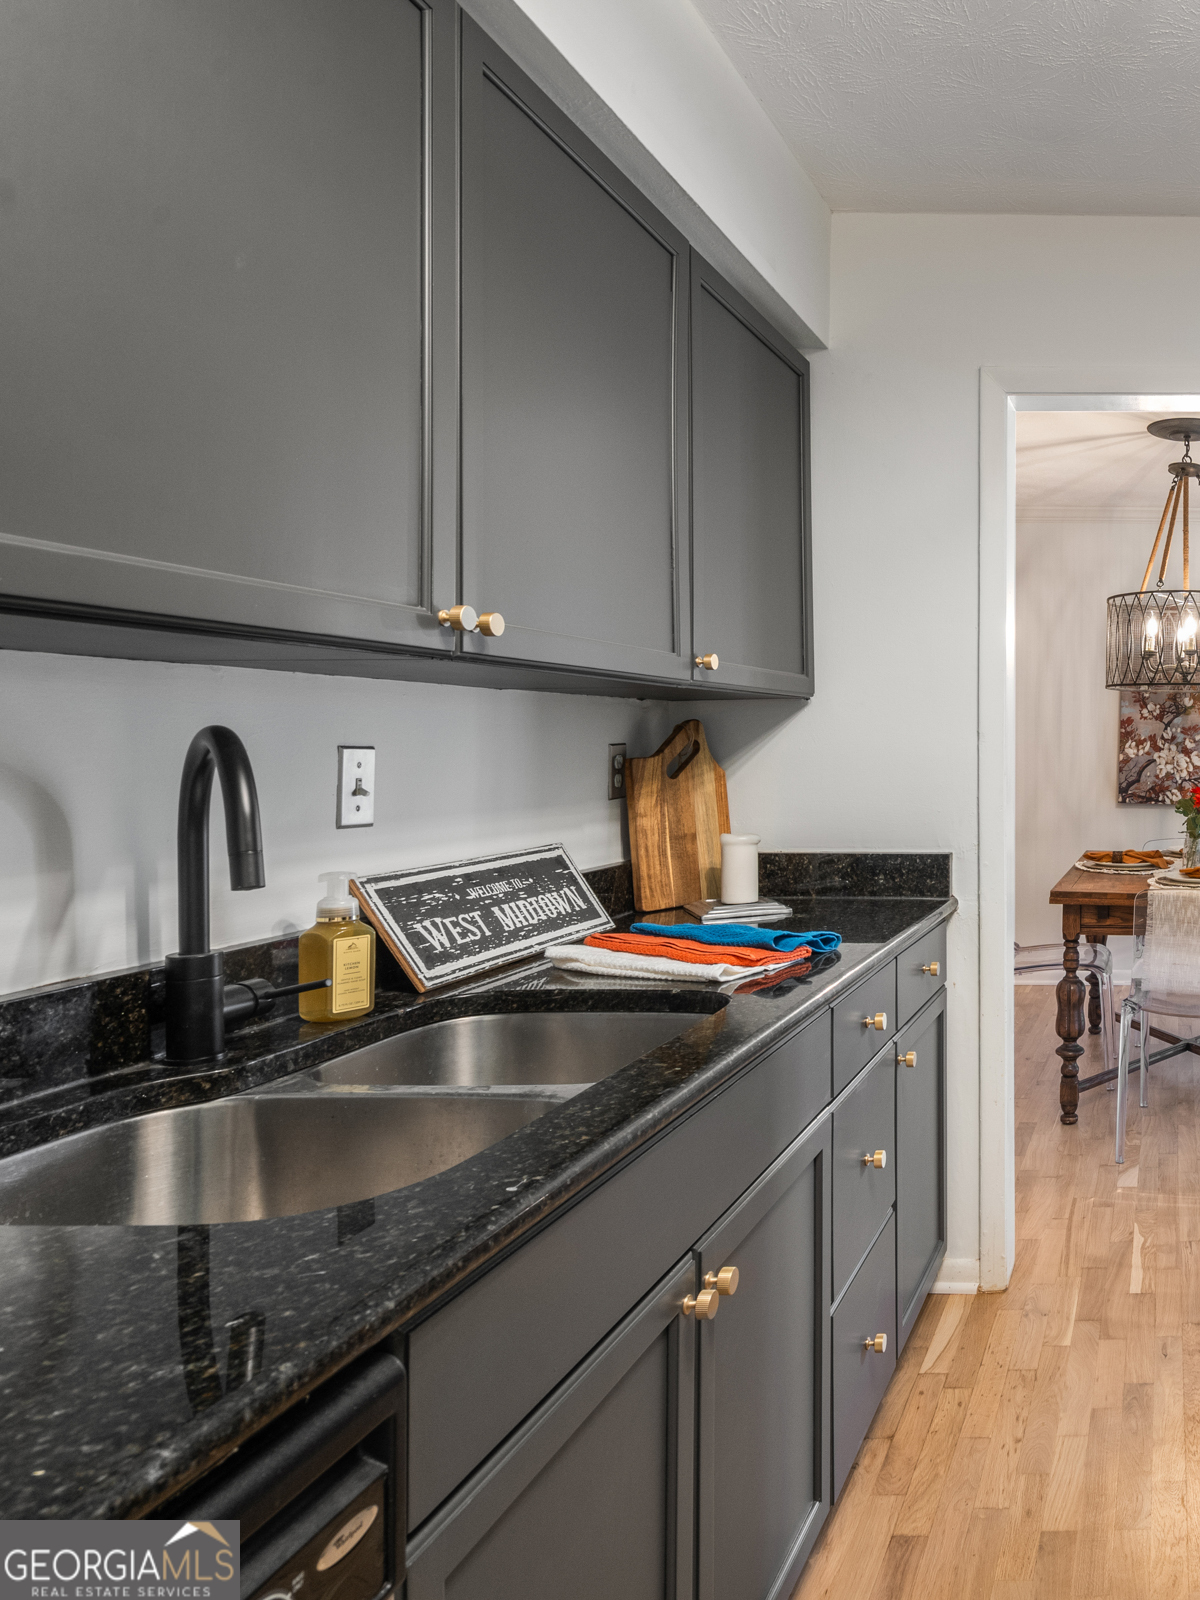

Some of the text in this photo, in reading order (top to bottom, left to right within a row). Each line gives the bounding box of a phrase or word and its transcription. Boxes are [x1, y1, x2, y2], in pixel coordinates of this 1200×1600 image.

[466, 878, 523, 899] WELCOME TO
[413, 886, 587, 951] WEST MIDTOWN
